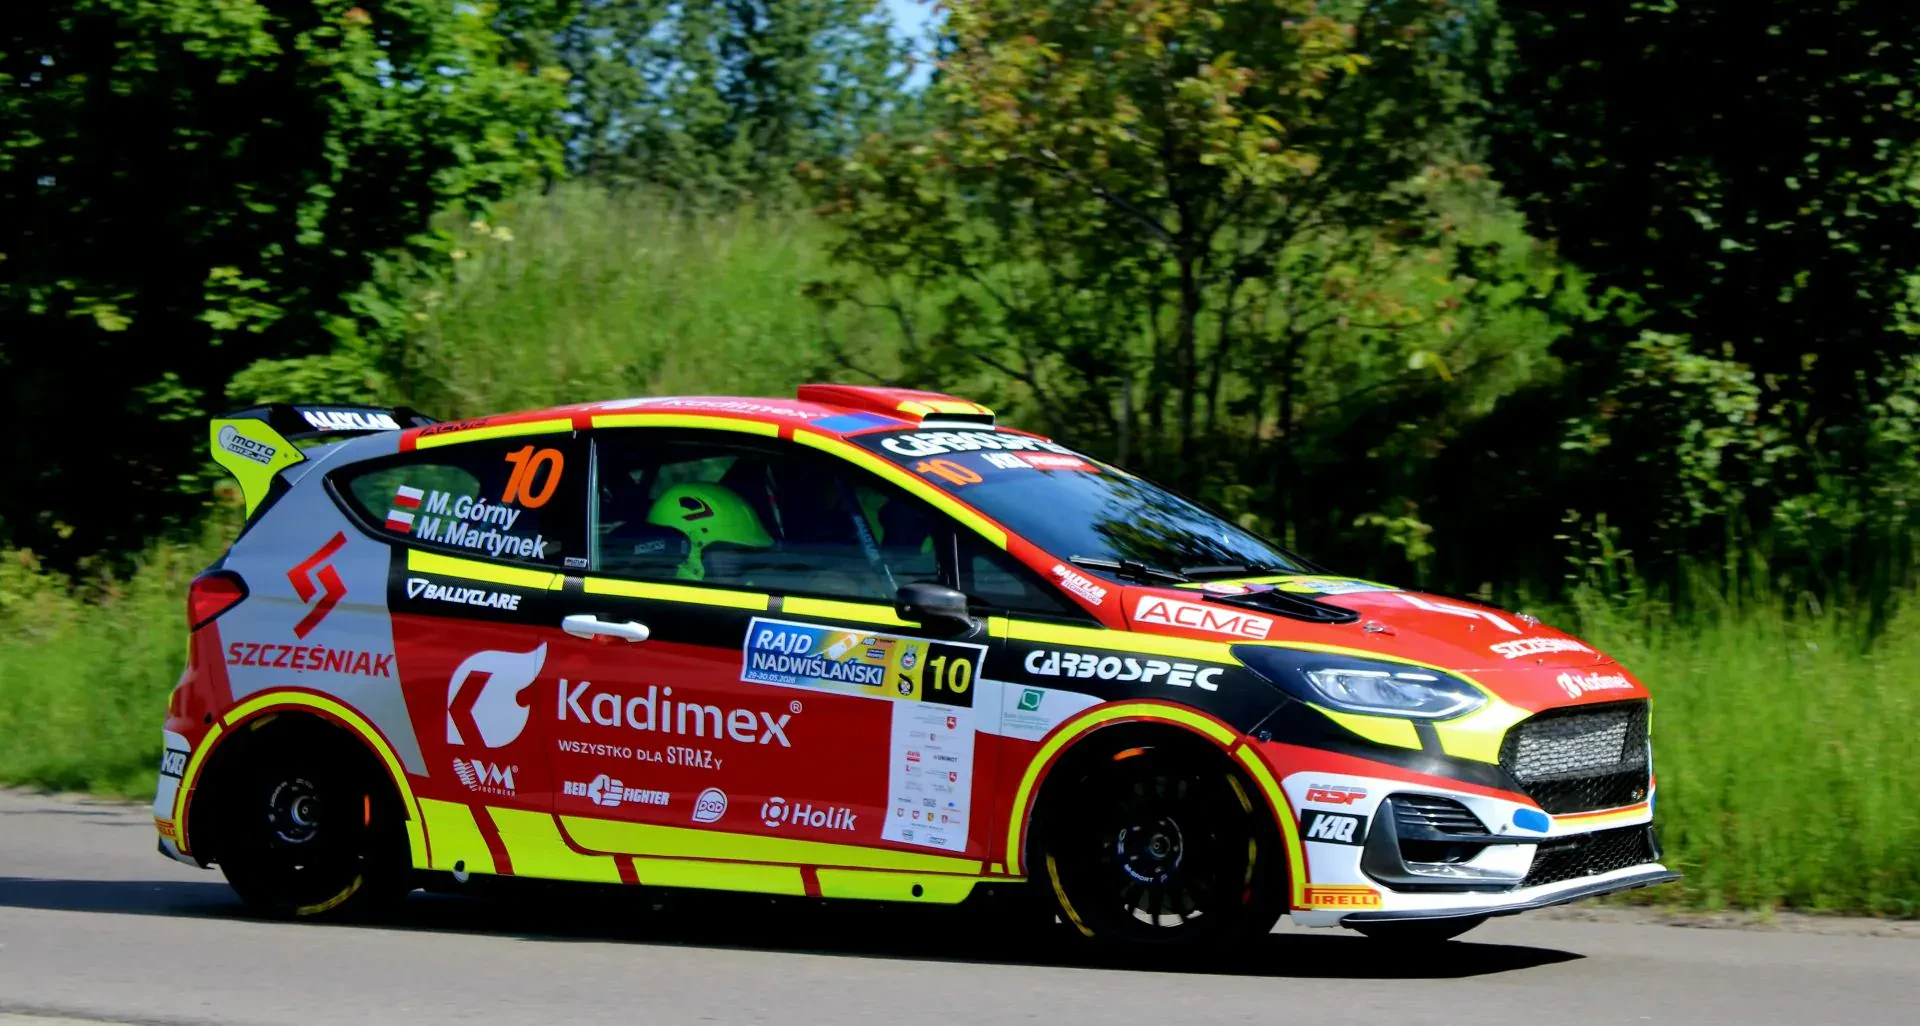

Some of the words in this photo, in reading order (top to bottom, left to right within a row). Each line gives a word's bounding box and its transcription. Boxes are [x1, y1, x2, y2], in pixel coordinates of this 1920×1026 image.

[231, 434, 277, 457] MOTO
[501, 445, 565, 509] 10
[915, 457, 984, 486] 10
[425, 490, 521, 532] M.Górny
[416, 515, 549, 560] M.Martynek
[423, 583, 522, 611] BALLYCLARE
[1140, 601, 1268, 637] ACME
[756, 629, 813, 655] RAJD
[227, 642, 395, 678] SZCZĘŚNIAK
[752, 651, 884, 686] NADWIŚLAŃSKI
[930, 655, 973, 694] 10
[1024, 650, 1224, 691] CARBOSPEC
[558, 739, 633, 759] WSZYSTKO
[636, 749, 663, 763] DLA
[563, 780, 587, 798] RED
[623, 787, 671, 806] FIGHTER
[791, 803, 858, 832] Holík
[1303, 886, 1378, 905] PIRELLI
